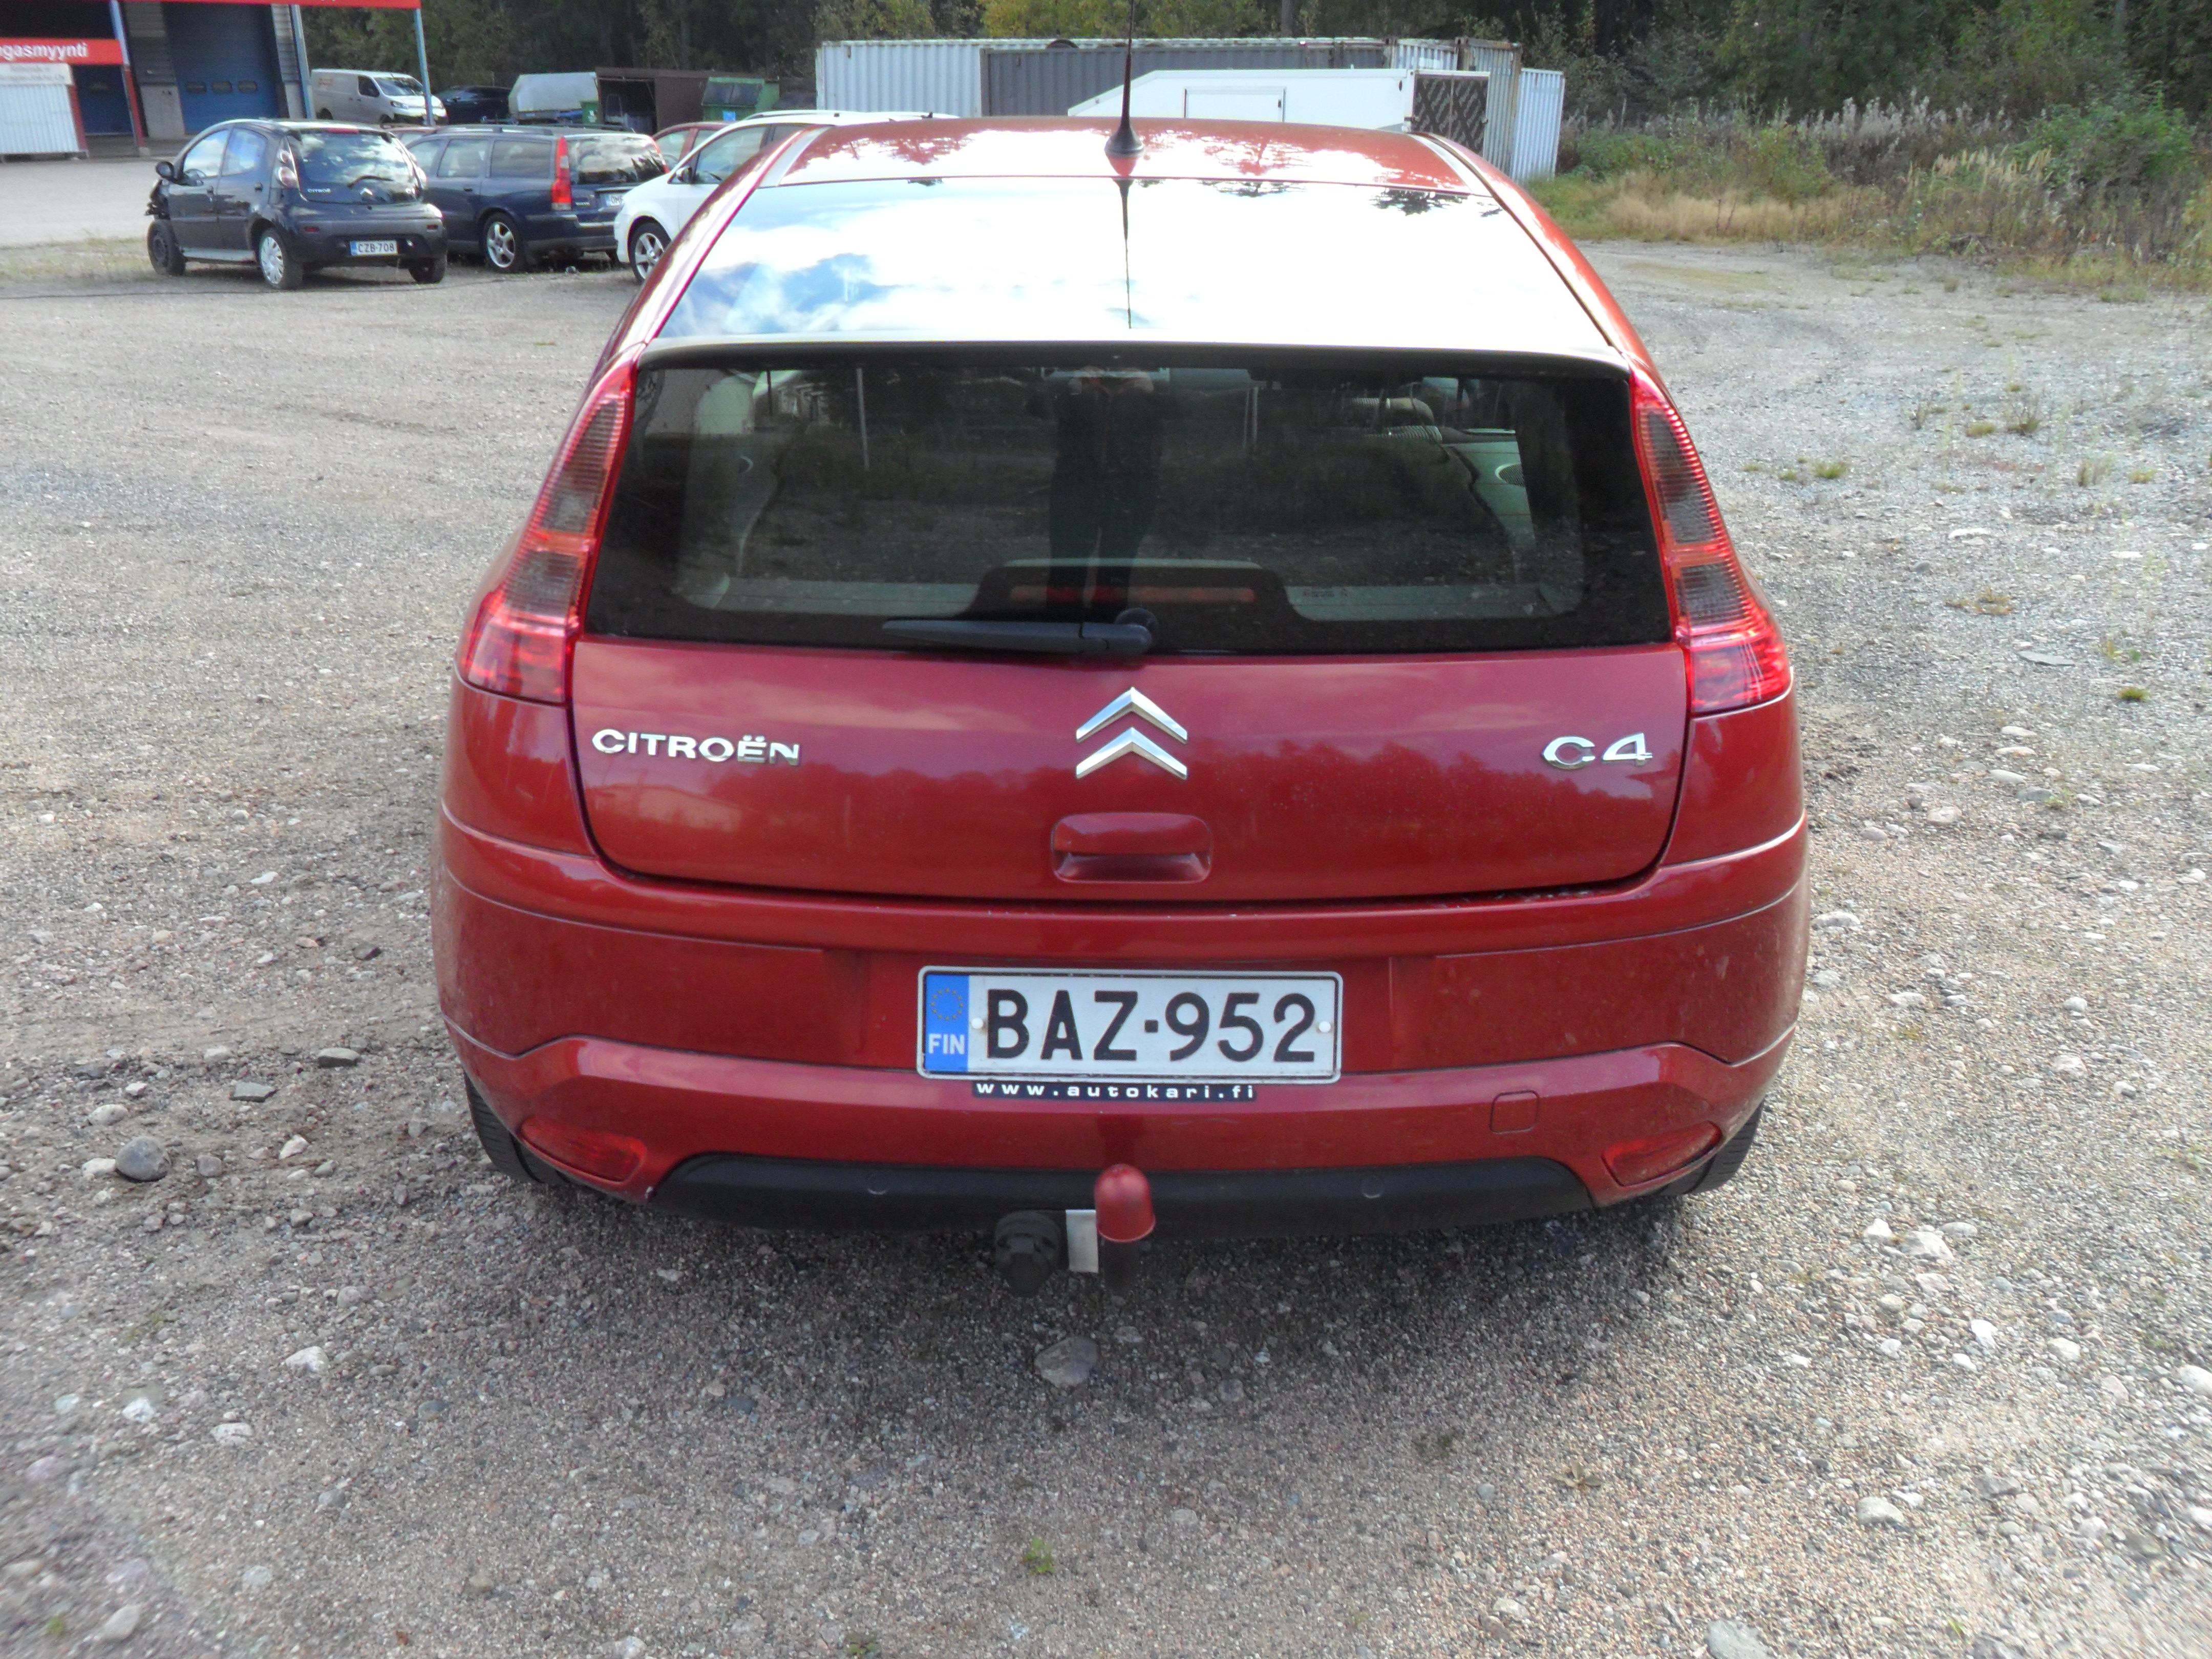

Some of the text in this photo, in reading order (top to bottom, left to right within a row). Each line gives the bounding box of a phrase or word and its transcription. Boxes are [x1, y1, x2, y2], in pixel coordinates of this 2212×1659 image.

[358, 244, 395, 253] CZB-708
[592, 729, 800, 766] CITROËN
[1541, 732, 1653, 770] C4
[986, 989, 1316, 1063] BAZ-952
[928, 1033, 965, 1055] FIN
[976, 1083, 1253, 1099] www.autokari.fi
